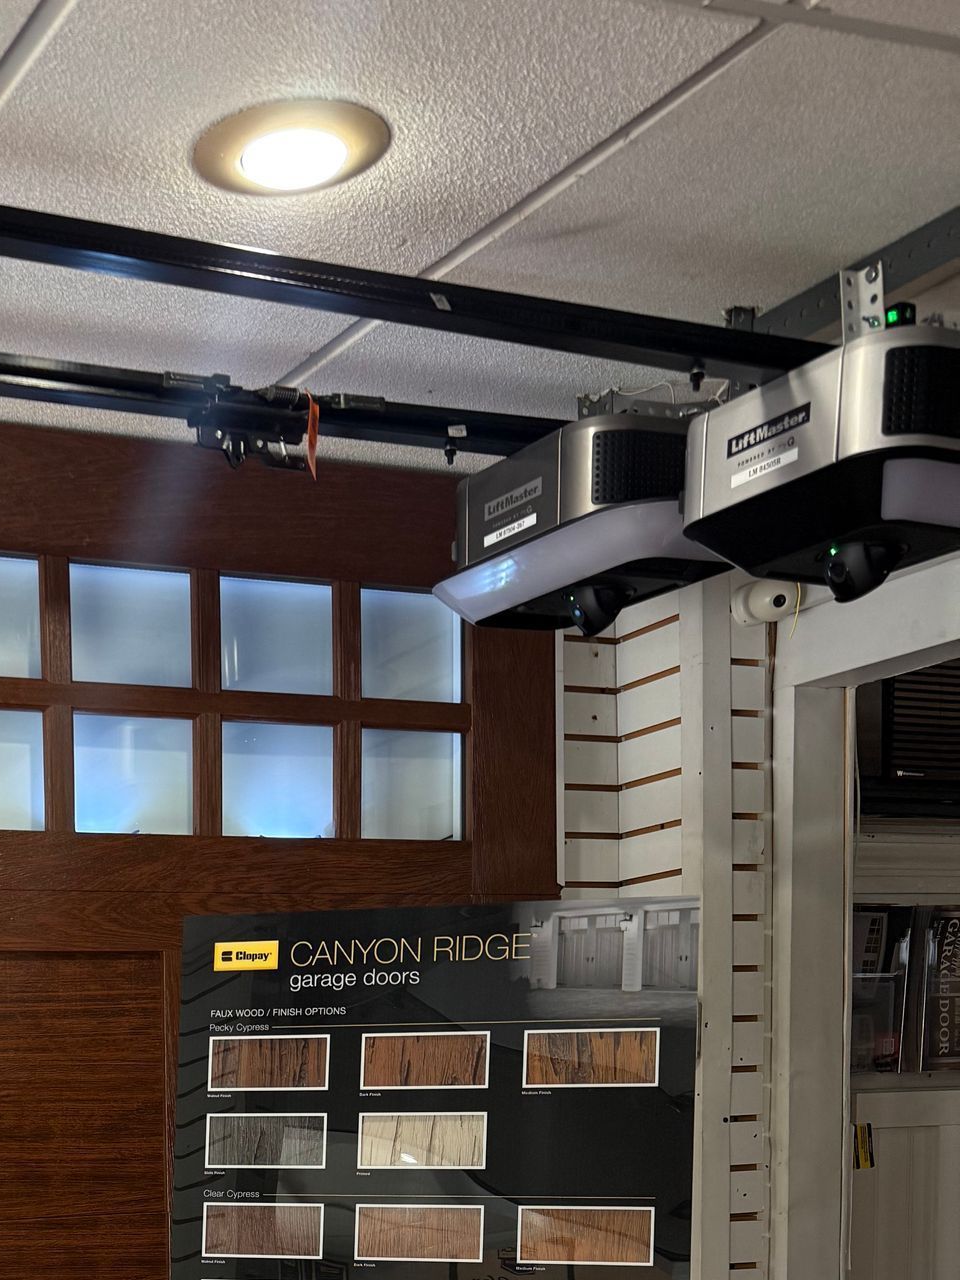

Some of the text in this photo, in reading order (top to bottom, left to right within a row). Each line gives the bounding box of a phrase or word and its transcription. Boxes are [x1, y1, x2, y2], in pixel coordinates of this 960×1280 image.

[731, 412, 807, 454] LiftMaster
[488, 485, 539, 517] LiftMaster
[235, 933, 531, 967] Clopay CANYON RIDGE
[289, 968, 420, 992] garage doors
[210, 1009, 233, 1018] FAUX
[236, 1008, 265, 1018] WOOD
[273, 1008, 303, 1017] FINISH
[305, 1006, 347, 1016] OPTIONS
[209, 1023, 269, 1032] Pecky Cypress
[938, 999, 950, 1056] DOOR
[203, 1189, 260, 1200] Clear Cypress
